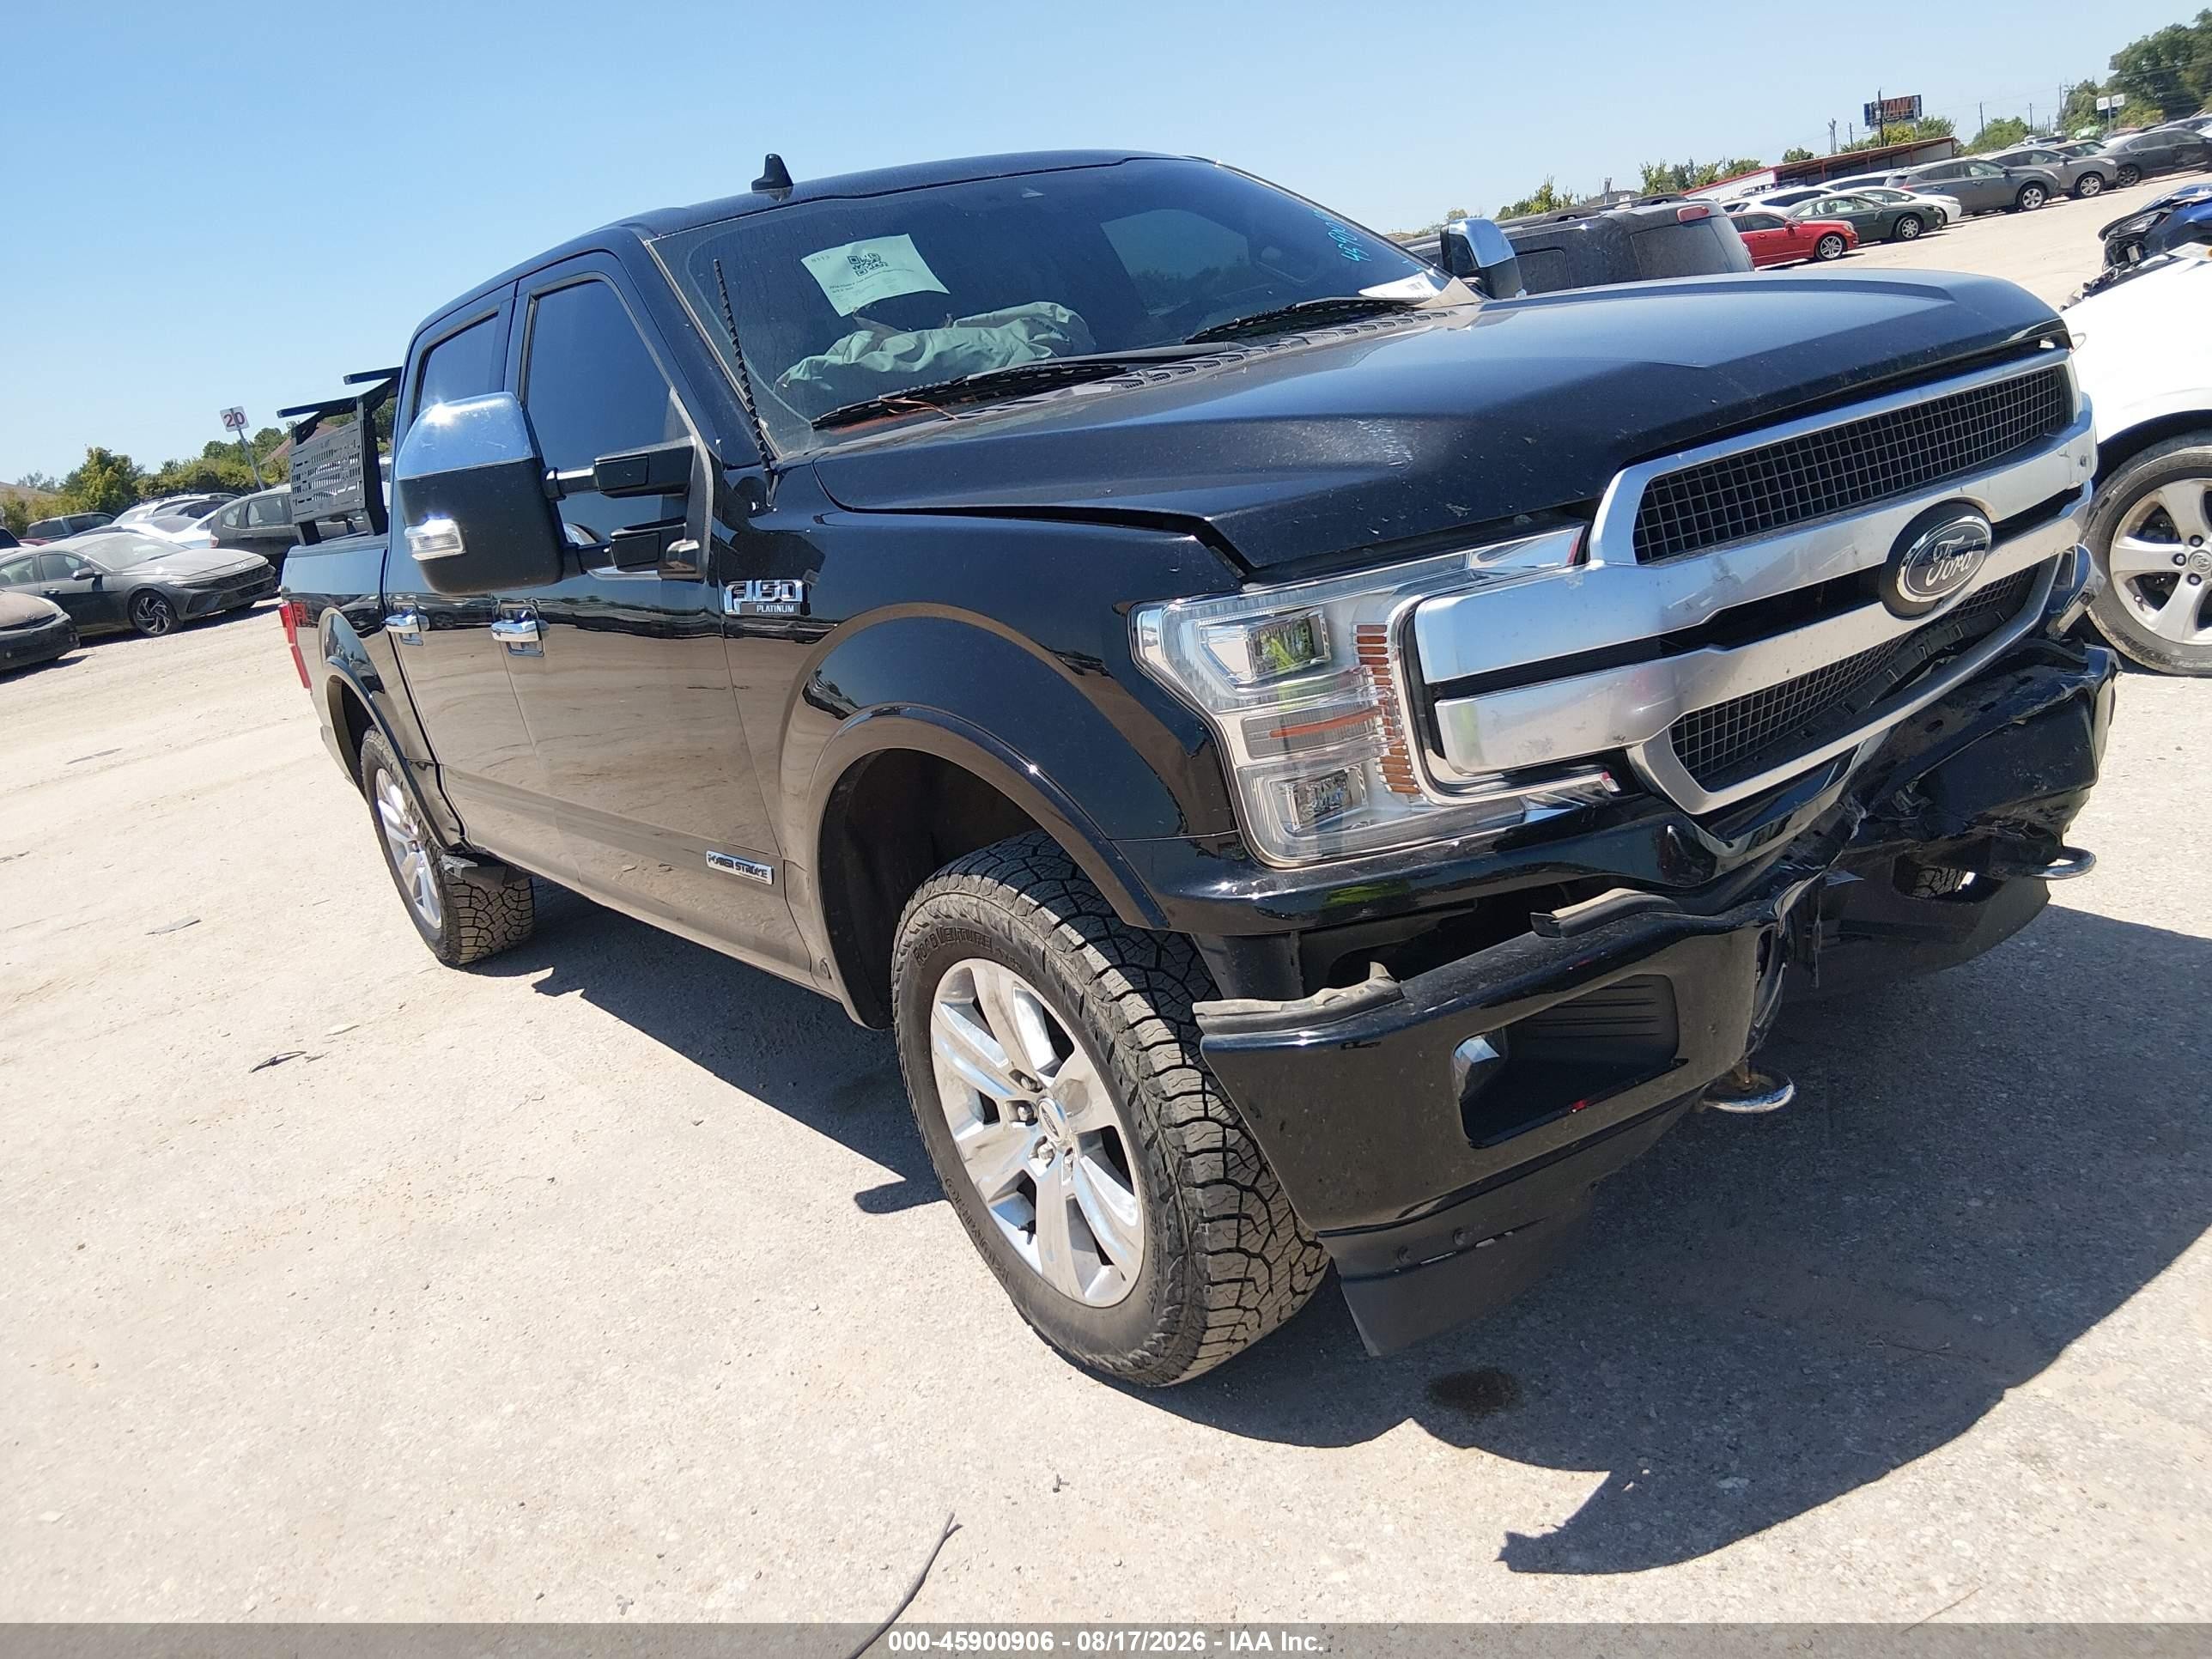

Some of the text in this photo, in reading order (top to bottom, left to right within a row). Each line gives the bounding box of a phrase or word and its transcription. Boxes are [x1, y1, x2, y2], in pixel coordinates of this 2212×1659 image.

[223, 411, 246, 428] 20
[1925, 534, 1977, 586] Ford
[757, 605, 794, 613] PLATINUM
